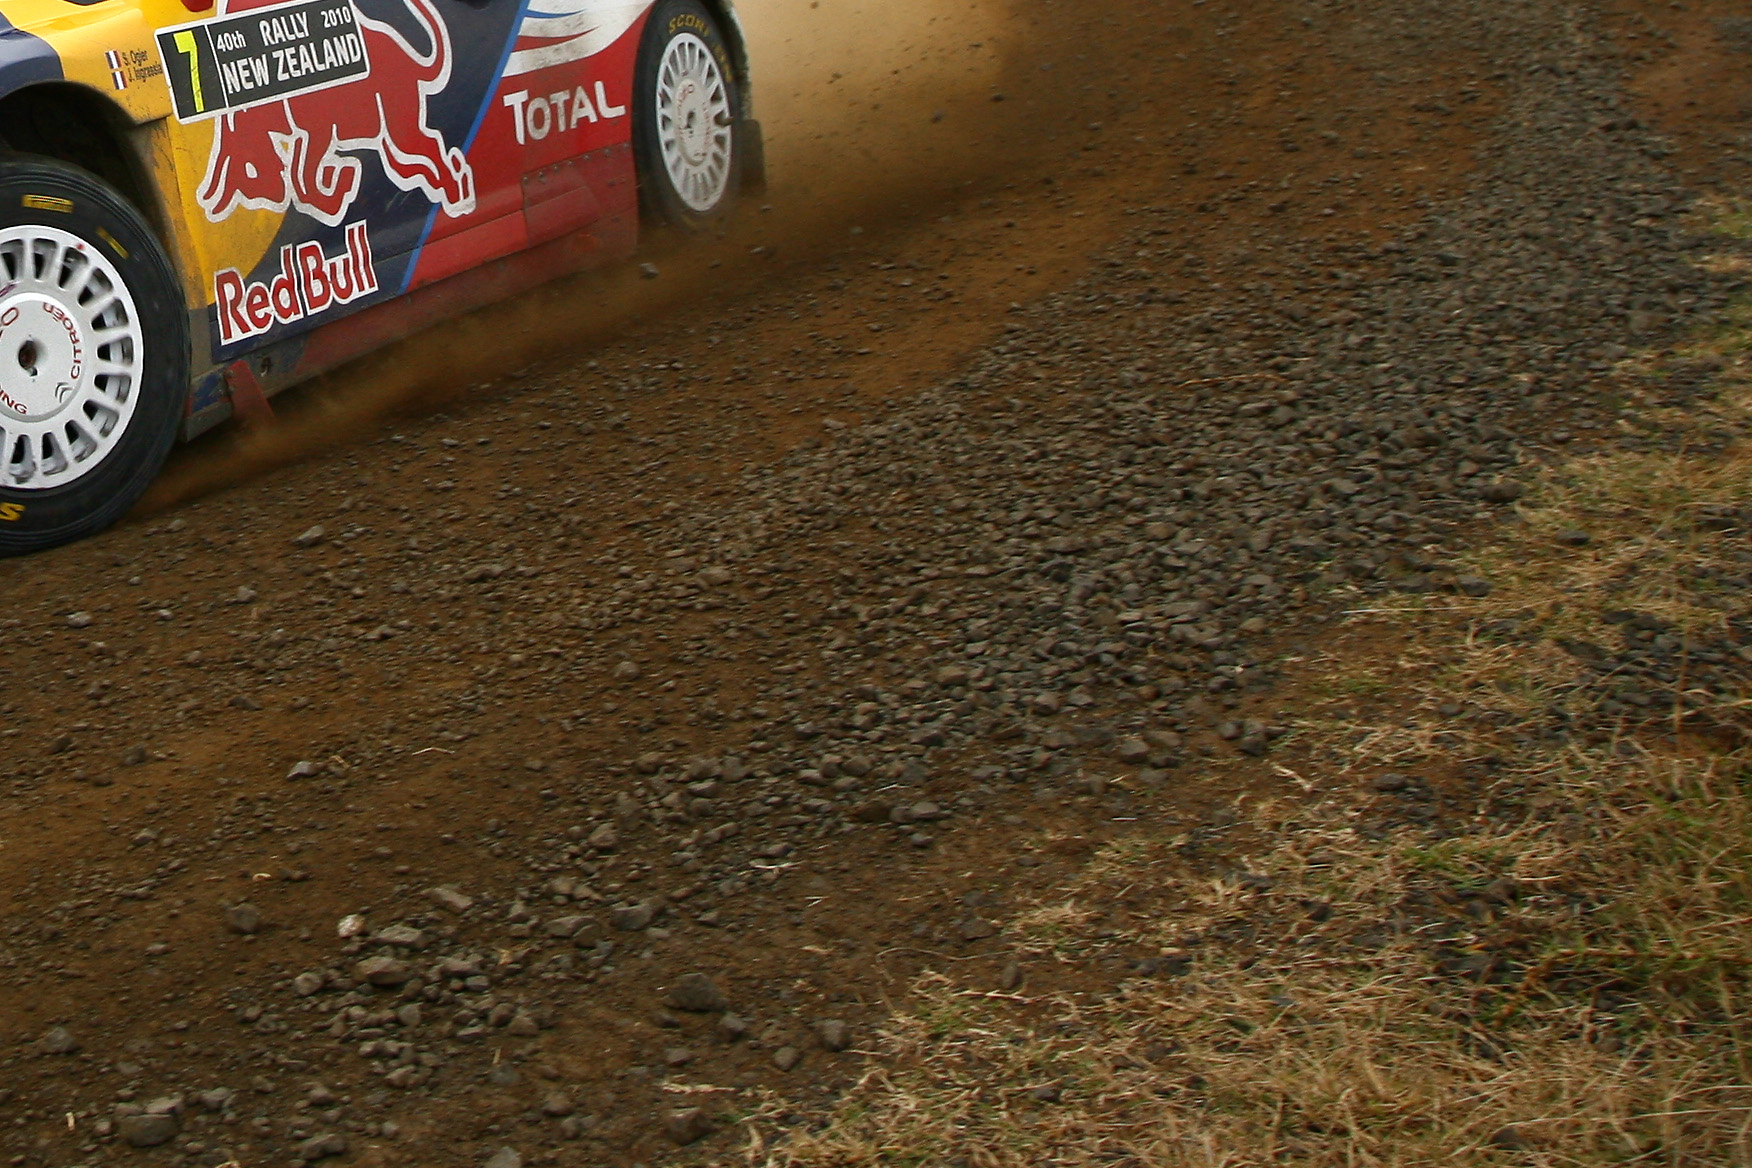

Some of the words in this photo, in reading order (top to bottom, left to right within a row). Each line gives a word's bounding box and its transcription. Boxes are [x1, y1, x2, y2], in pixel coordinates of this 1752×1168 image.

[216, 30, 247, 53] 40th
[259, 11, 310, 46] RALLY
[321, 6, 352, 28] 2010
[173, 30, 205, 113] 7
[222, 53, 269, 94] NEW
[272, 33, 362, 82] ZEALAND
[503, 80, 626, 145] TOTAL
[215, 244, 303, 343] Red
[298, 221, 377, 313] Bull
